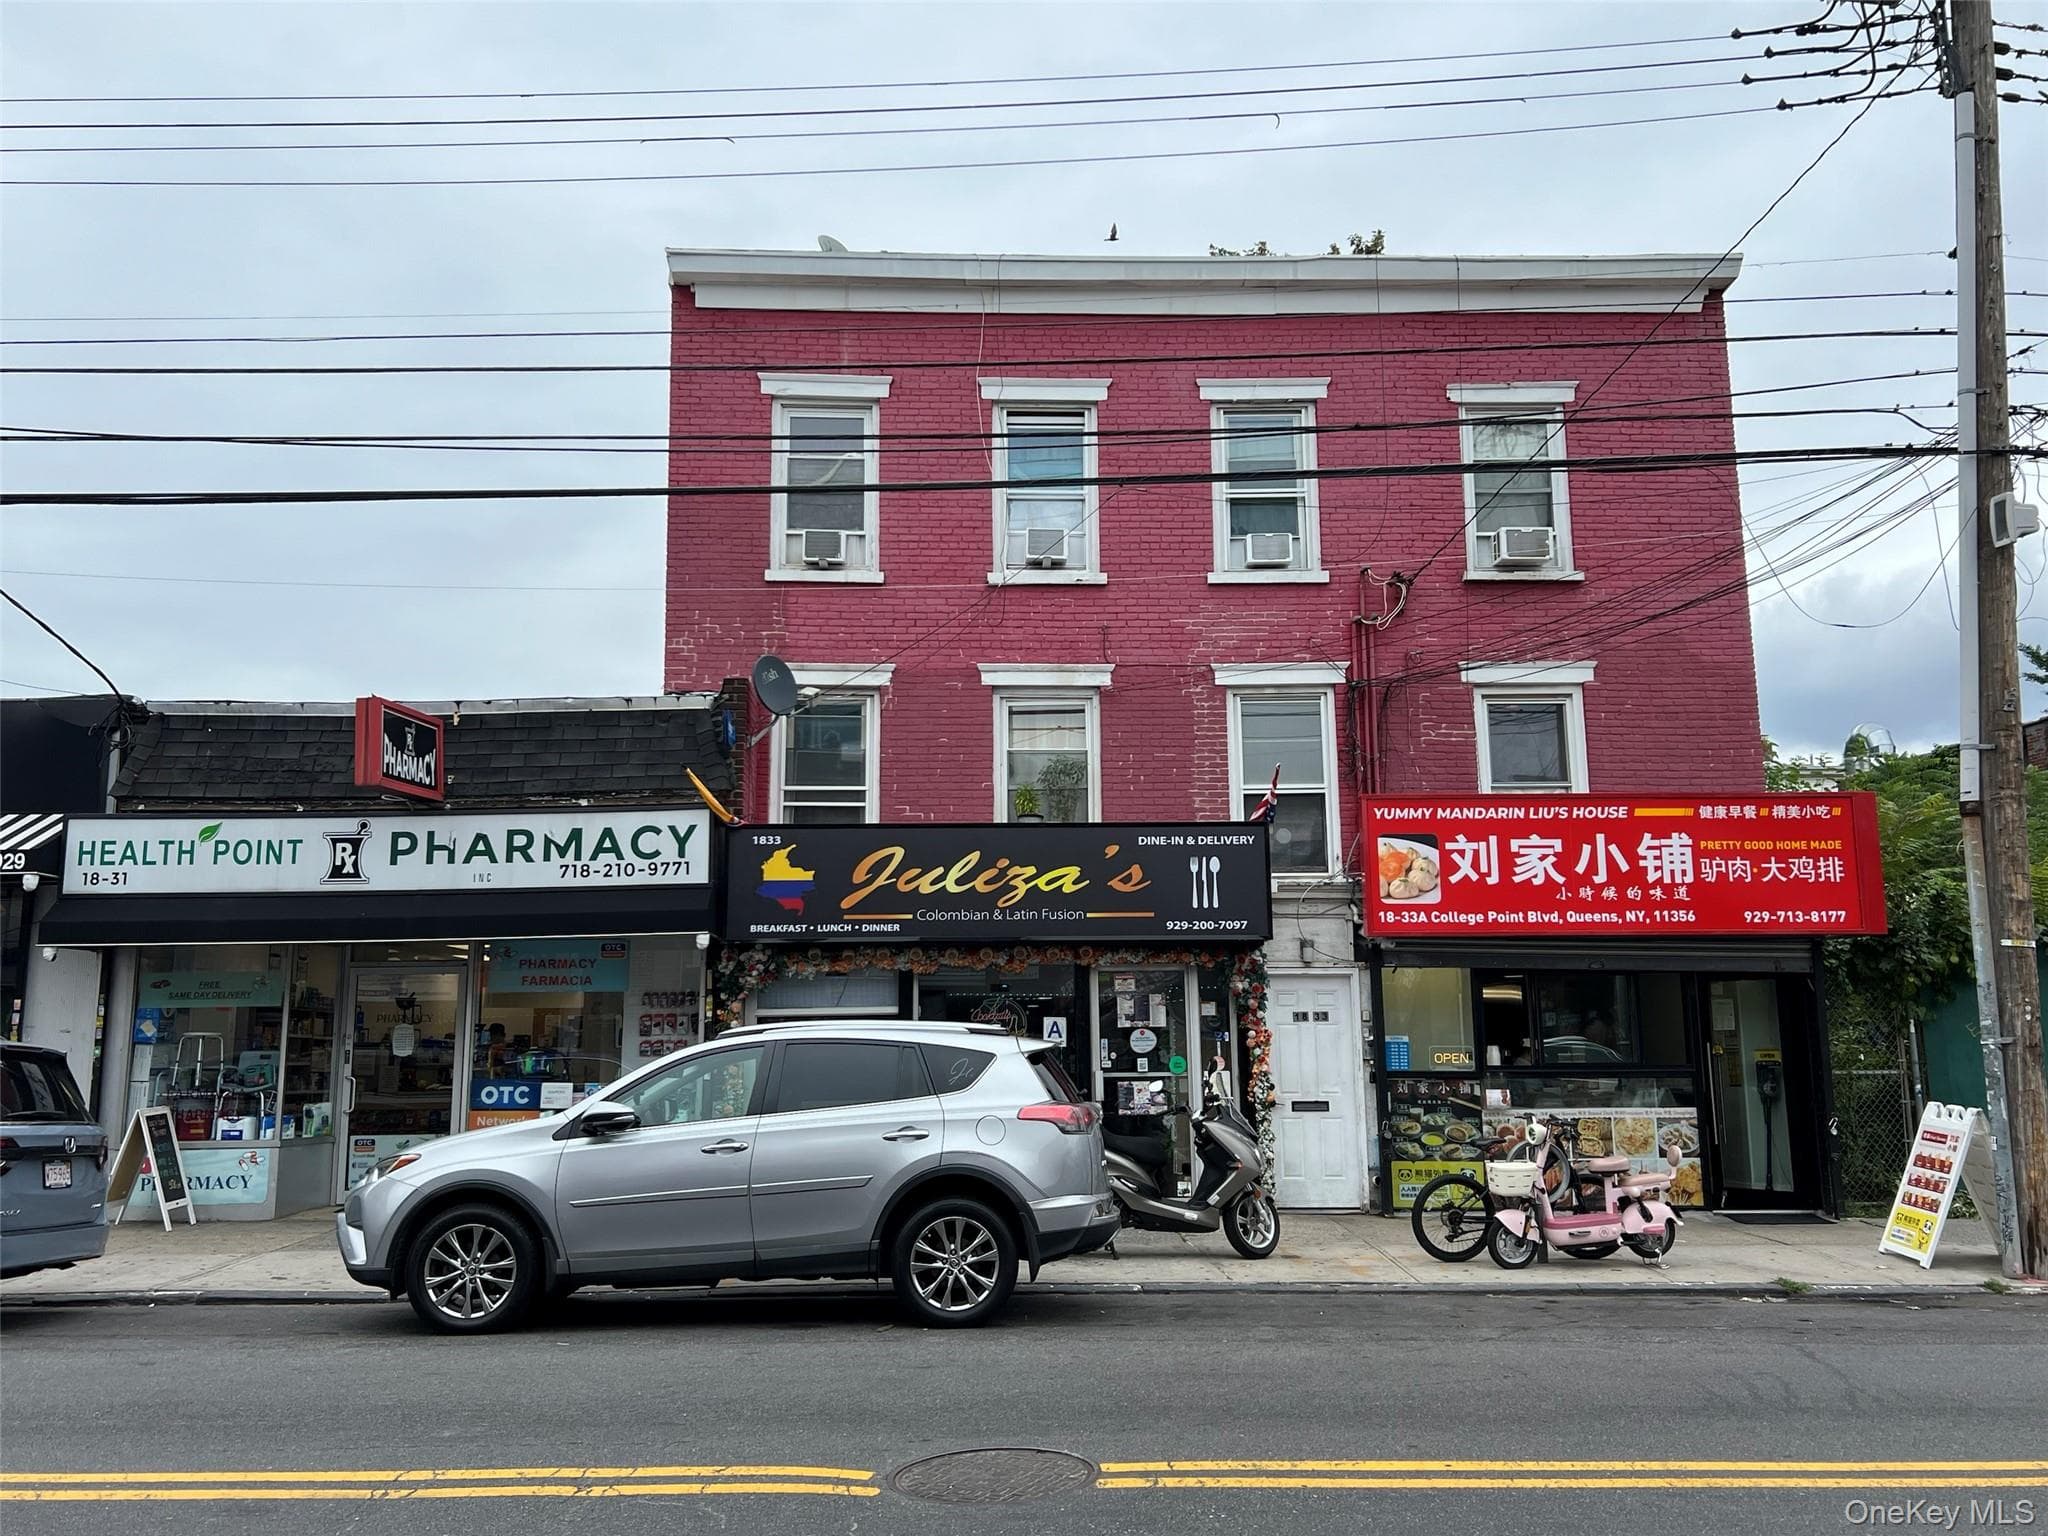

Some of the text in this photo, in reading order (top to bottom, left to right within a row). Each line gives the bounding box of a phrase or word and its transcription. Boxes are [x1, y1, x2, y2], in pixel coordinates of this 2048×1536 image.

[383, 732, 436, 786] PHARMACY
[1374, 806, 1628, 820] YUMMY MANDARIN LIU'S HOUSE
[1699, 805, 1831, 819] 健康早餐 精美小吃
[390, 824, 697, 866] PHARMACY
[752, 836, 781, 845] 1833
[1138, 835, 1255, 845] DINE-IN & DELIVERY
[1700, 840, 1842, 850] PRETTY GOOD HOME MADE
[77, 839, 303, 867] HEALTH POINT
[1444, 832, 1694, 886] 刘家小铺
[0, 853, 25, 869] 29
[560, 861, 690, 878] 718-210-9771
[840, 844, 1151, 909] Juliza's
[82, 872, 128, 886] 18-31
[473, 872, 492, 883] INC
[1556, 885, 1691, 901] 小時候的味道
[917, 909, 1084, 921] Colombian & Latin Fusion
[1378, 910, 1696, 926] 18-33A College Point Blvd, Queens, NY, 11356
[1744, 911, 1846, 923] 929-713-8177
[750, 923, 900, 933] BREAKFAST LUNCH DINNER
[1166, 920, 1248, 930] 929-200-7097
[519, 958, 597, 969] PHARMACY
[199, 981, 220, 989] FREE
[521, 976, 593, 986] FARMACIA
[168, 992, 190, 1000] SAME
[212, 991, 252, 999] DELIVERY
[1047, 1021, 1062, 1039] A
[1434, 1053, 1469, 1064] OPEN
[480, 1086, 530, 1105] OTC
